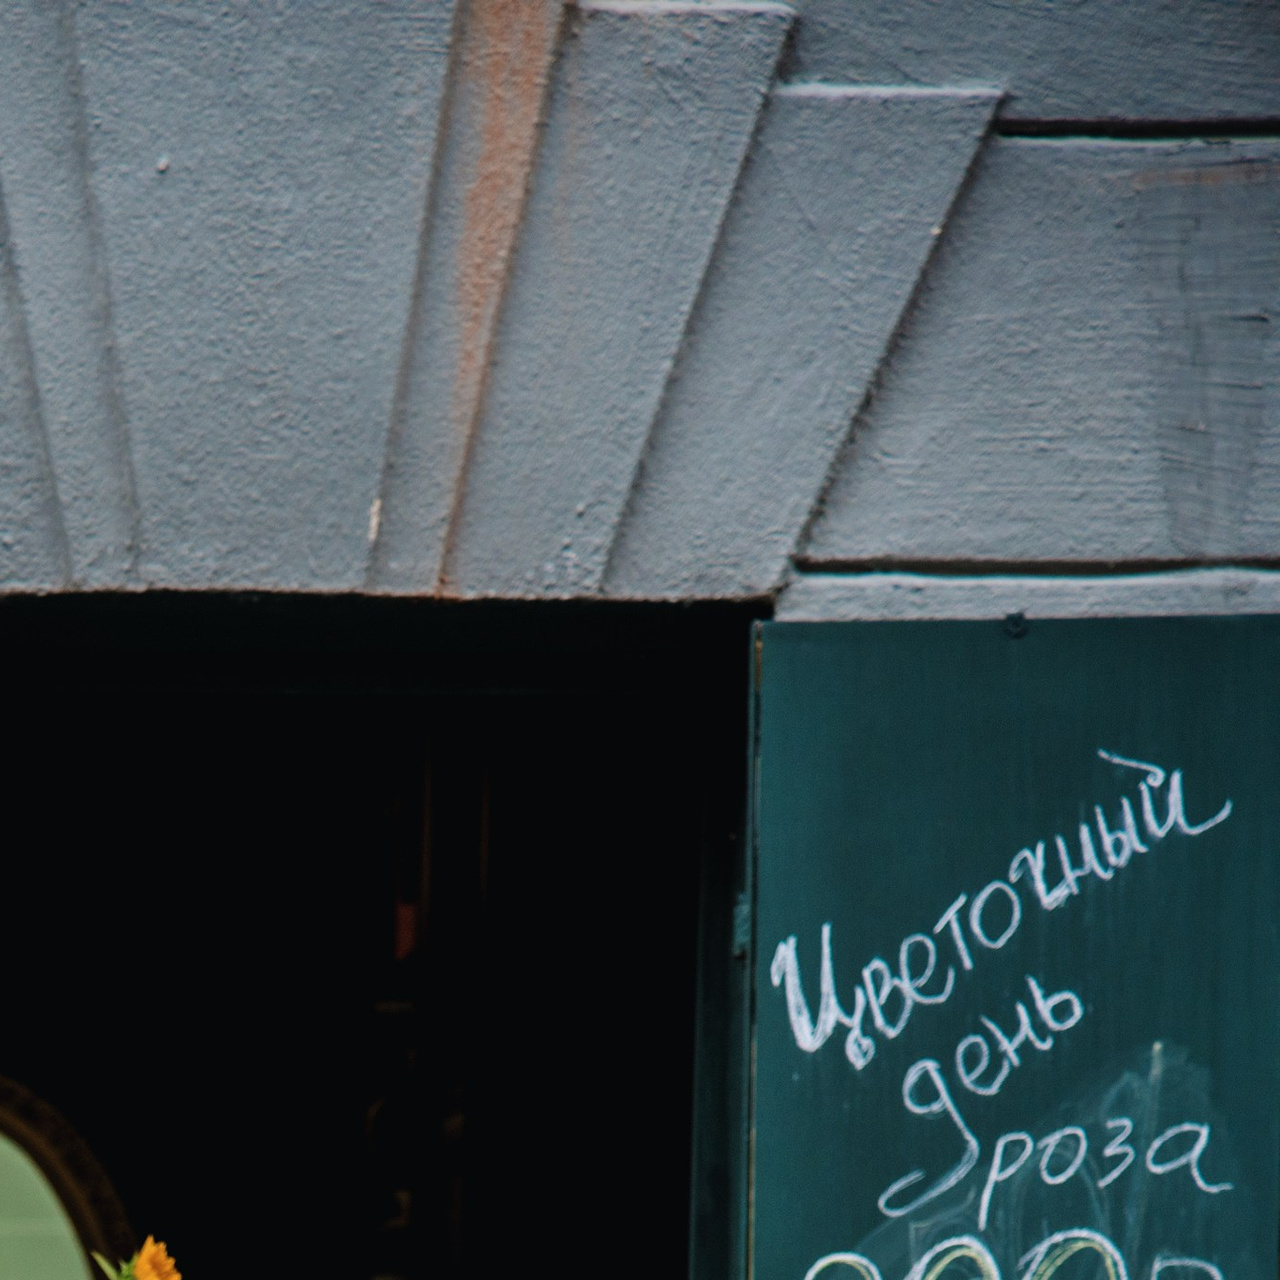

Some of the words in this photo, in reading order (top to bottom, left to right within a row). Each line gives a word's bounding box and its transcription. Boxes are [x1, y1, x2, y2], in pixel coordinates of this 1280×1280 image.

[772, 749, 1233, 1070] Цветочный
[878, 976, 1083, 1217] день
[978, 1116, 1233, 1232] роза
